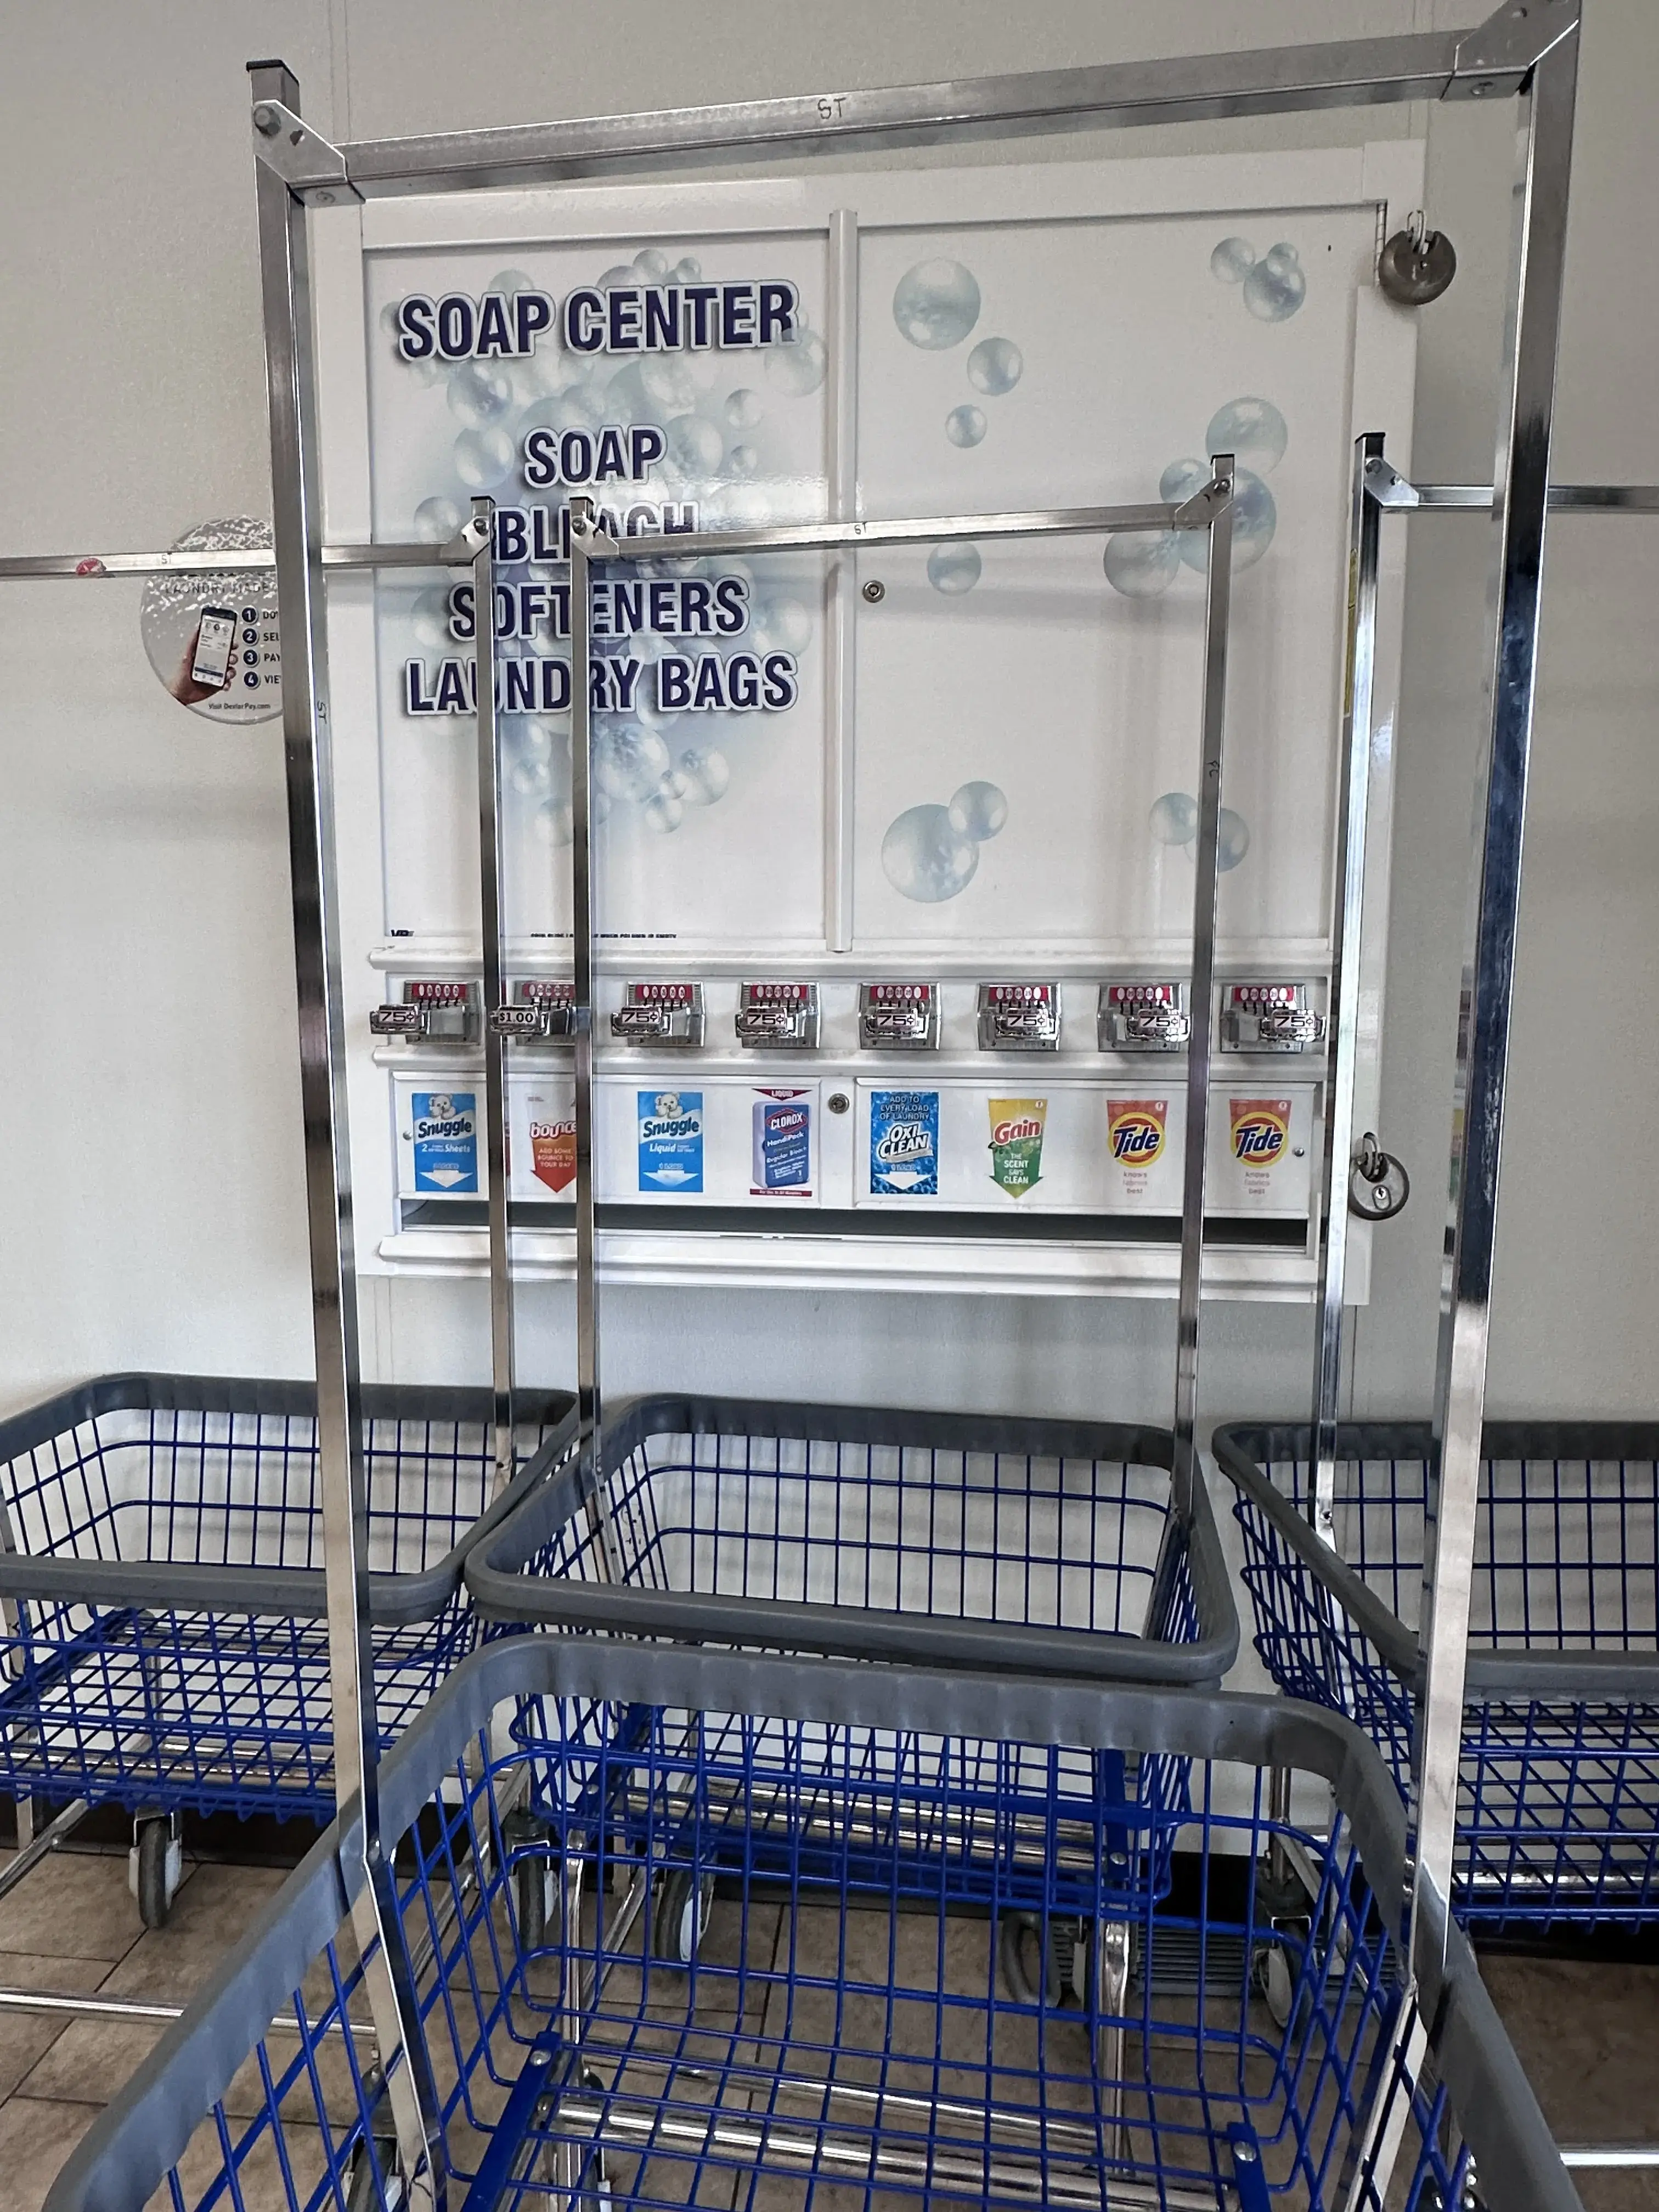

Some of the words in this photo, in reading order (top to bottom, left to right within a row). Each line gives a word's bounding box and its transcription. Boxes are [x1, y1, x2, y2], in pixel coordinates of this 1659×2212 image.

[817, 97, 847, 120] ST
[400, 292, 552, 359] SOAP
[567, 283, 795, 352] CENTER
[527, 427, 664, 485] SOAP
[262, 611, 279, 619] DO
[661, 653, 795, 709] BAGS
[317, 700, 327, 724] ST
[380, 1011, 415, 1023] 75¢
[499, 1011, 534, 1023] $1.00
[622, 1011, 659, 1023] 75¢
[748, 1014, 785, 1025] 75¢
[879, 1014, 915, 1026] 75¢
[1009, 1015, 1046, 1026] 75¢
[1141, 1015, 1179, 1028] 75¢
[1276, 1016, 1314, 1028] 75¢
[643, 1116, 699, 1138] Snuggle
[770, 1113, 803, 1130] CLOROX
[418, 1118, 472, 1138] Snuggle
[994, 1119, 1040, 1144] Gain
[421, 1143, 428, 1152] 2
[1114, 1126, 1160, 1158] Tide
[1235, 1126, 1283, 1158] Tide
[649, 1143, 676, 1154] Liquid
[1003, 1160, 1029, 1169] SCENT
[1003, 1176, 1029, 1184] CLEAN
